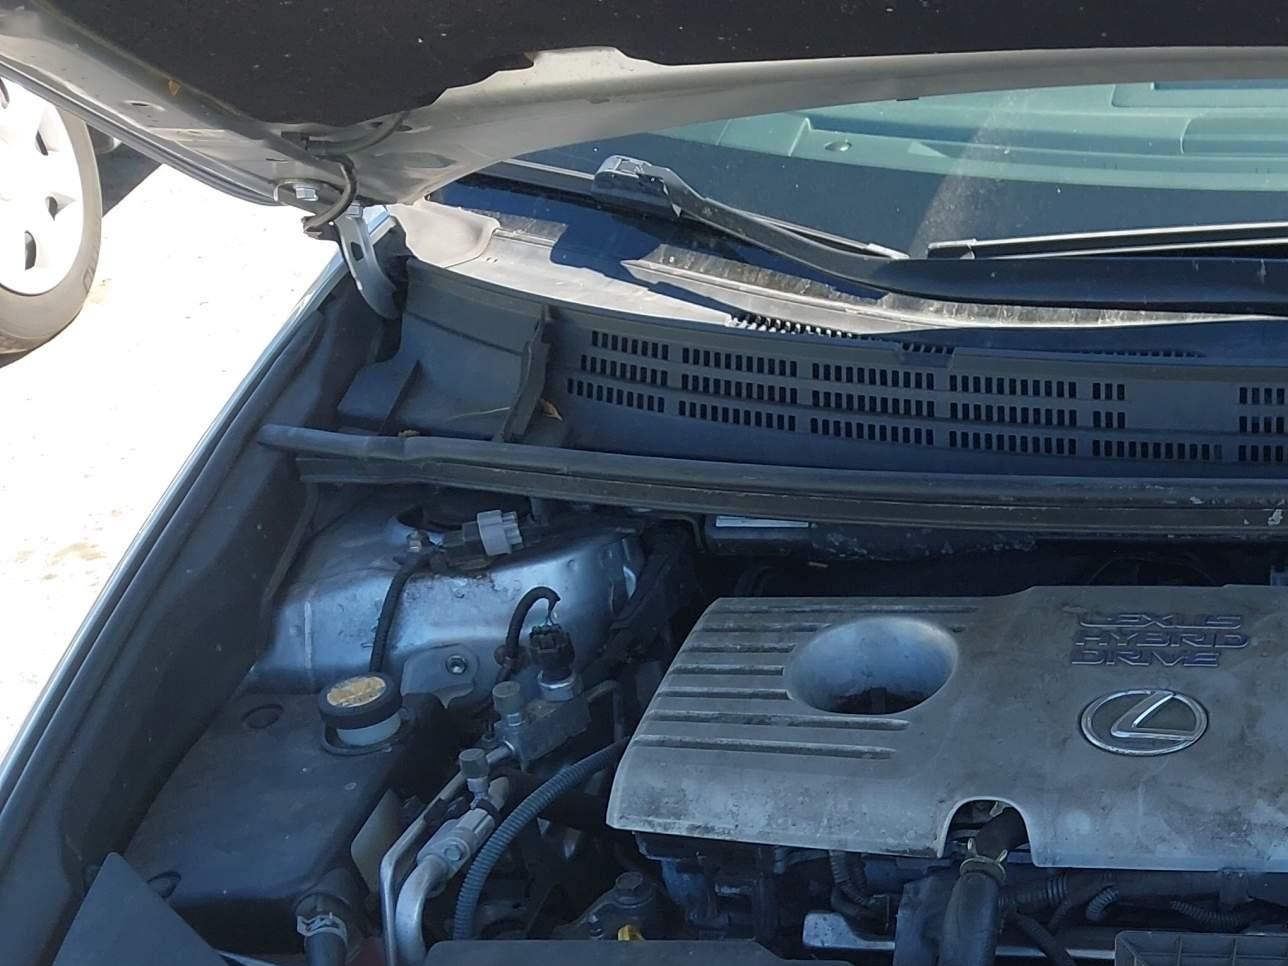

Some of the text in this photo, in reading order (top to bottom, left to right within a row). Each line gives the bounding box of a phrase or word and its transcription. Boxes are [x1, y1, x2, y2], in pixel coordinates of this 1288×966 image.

[1079, 612, 1241, 630] LEXUS
[1074, 632, 1249, 649] HYBRID
[1071, 650, 1220, 667] DRIVE
